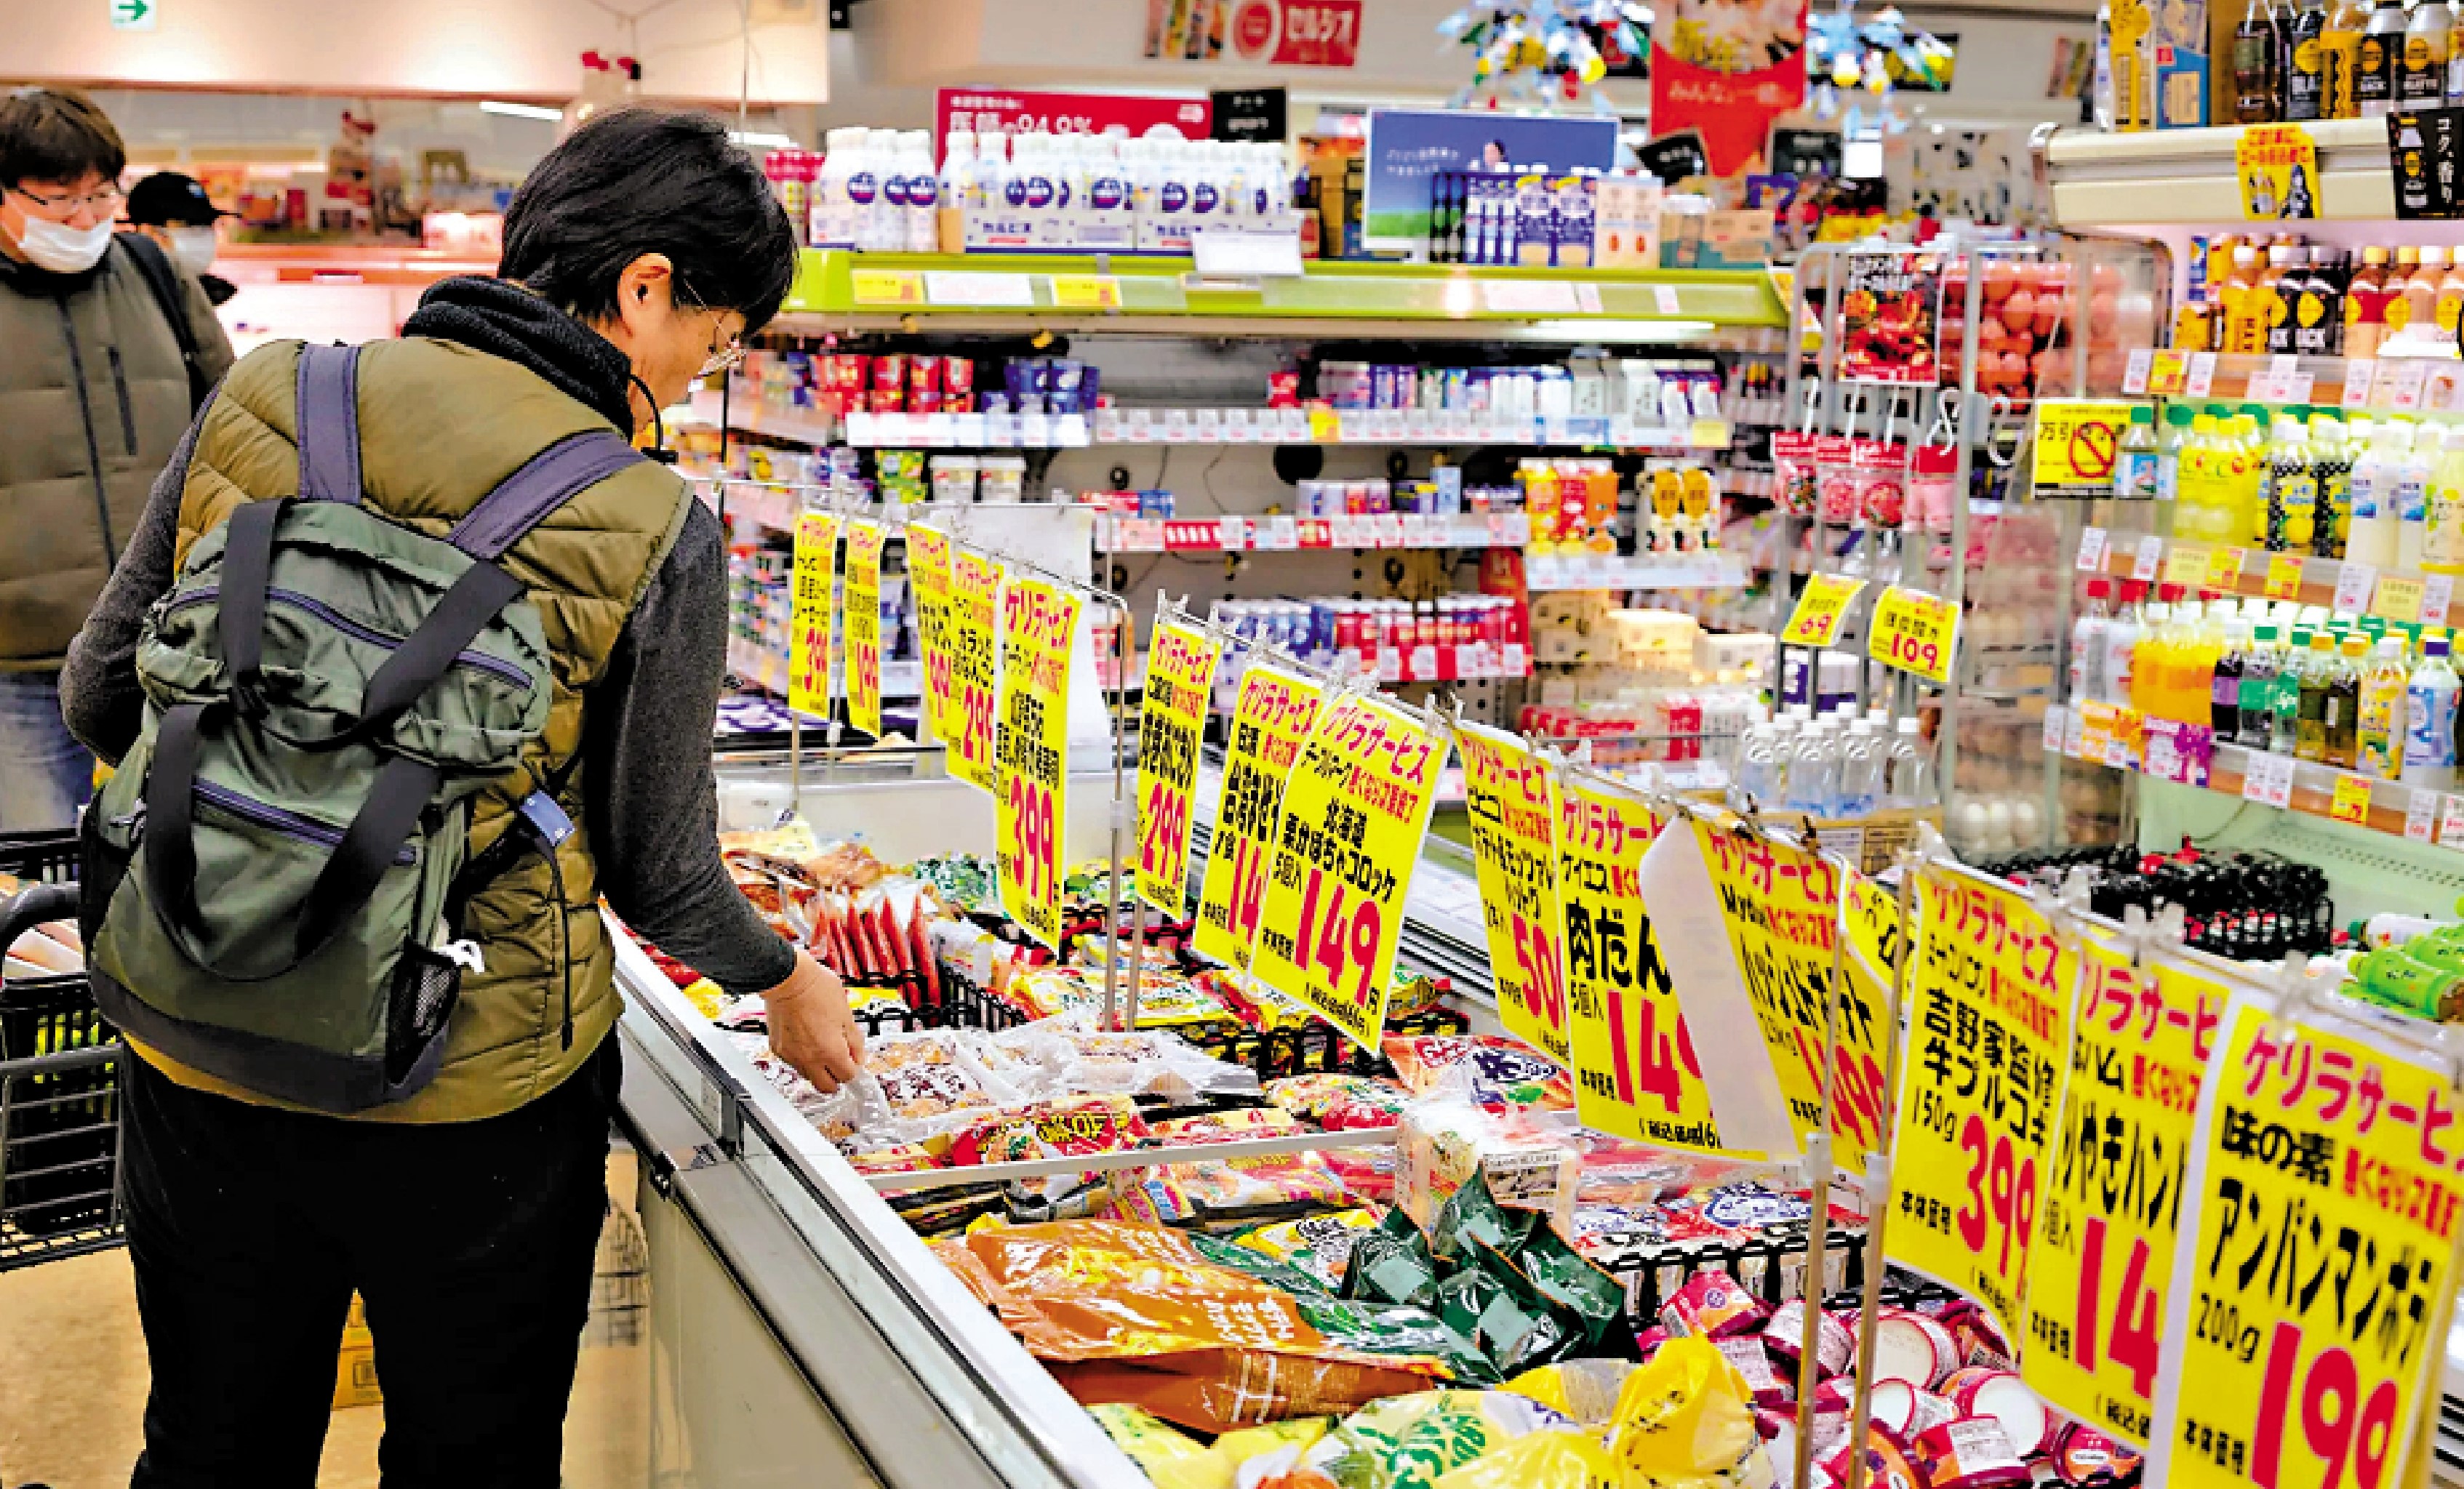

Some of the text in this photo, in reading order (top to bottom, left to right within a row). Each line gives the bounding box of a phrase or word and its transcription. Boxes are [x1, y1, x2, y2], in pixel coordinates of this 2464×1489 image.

[1891, 633, 1937, 671] 109
[1010, 774, 1054, 907] 399
[1142, 782, 1186, 887] 299
[1323, 798, 1367, 848] 北海道
[1227, 838, 1269, 945] 14
[1293, 868, 1380, 1008] 149
[1565, 898, 1673, 1000] 肉だん
[1924, 988, 2054, 1107] 吉野家監修
[1913, 1082, 1960, 1142] 150g
[2220, 1105, 2334, 1189] 味の素
[1956, 1112, 2036, 1296] 399
[2196, 1292, 2260, 1364] 200g
[2249, 1320, 2399, 1489] 199
